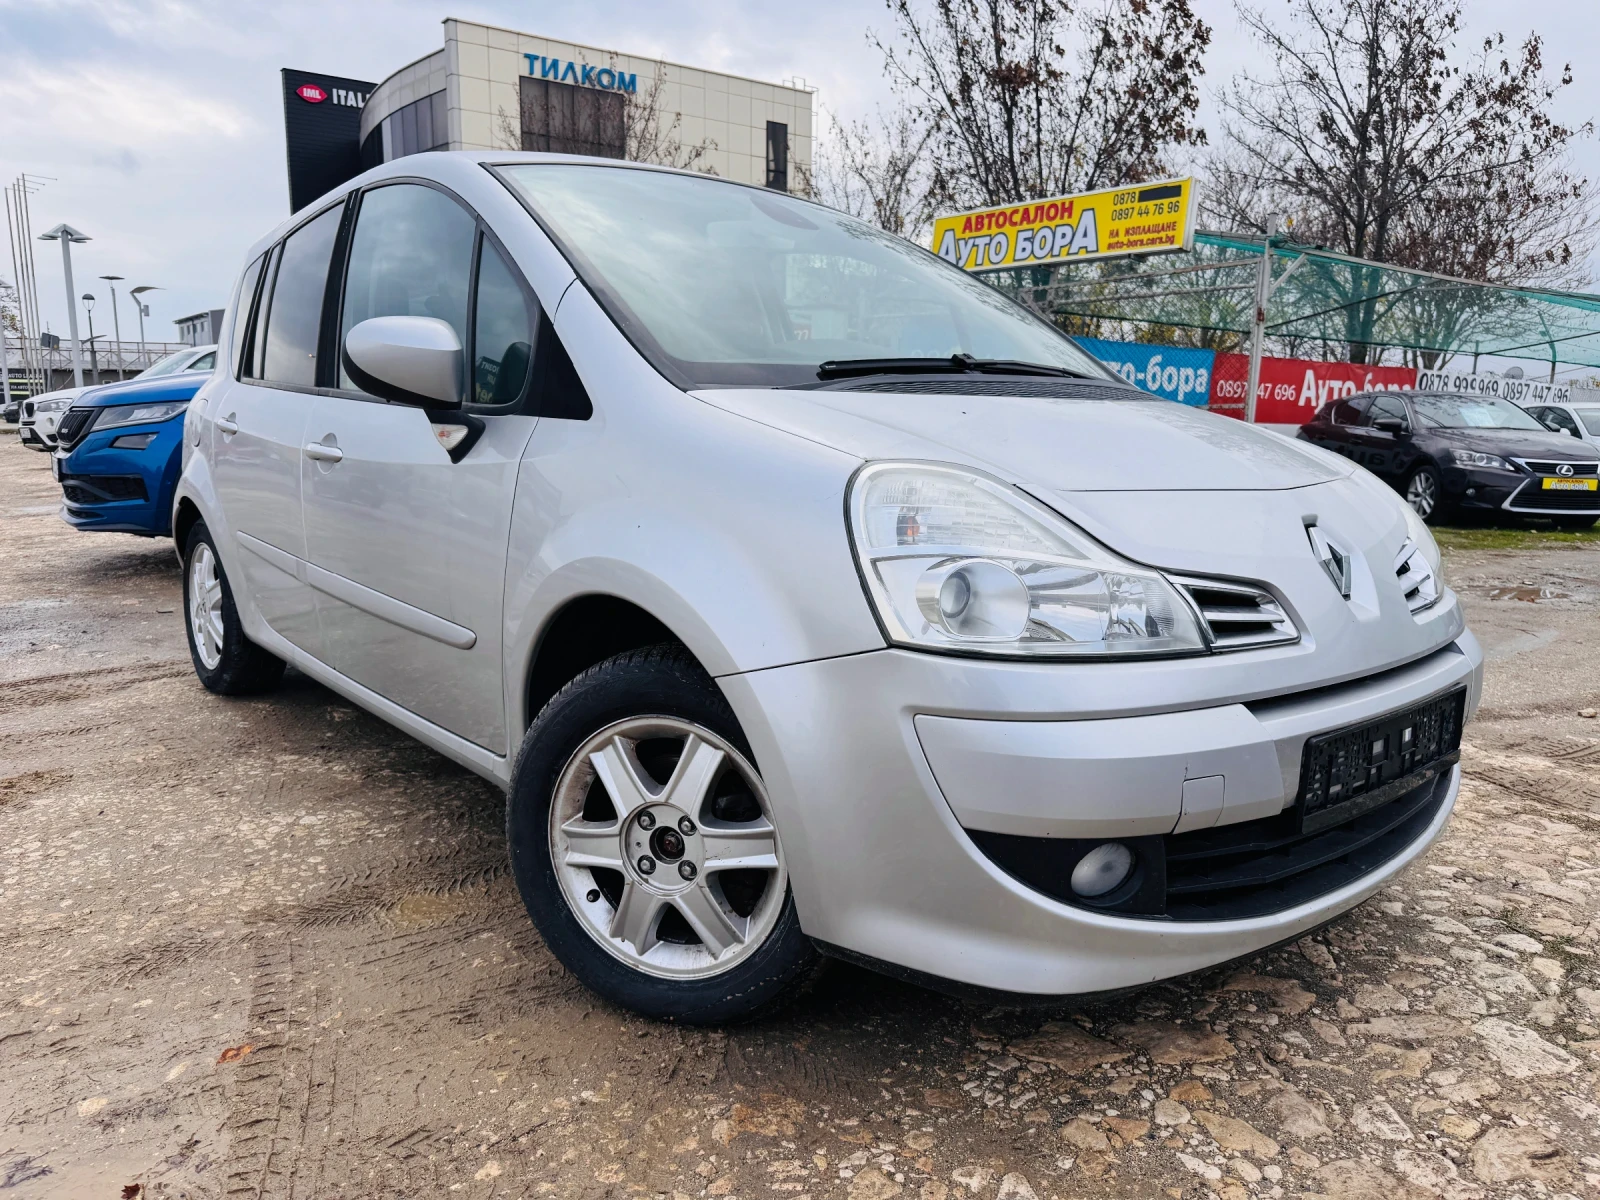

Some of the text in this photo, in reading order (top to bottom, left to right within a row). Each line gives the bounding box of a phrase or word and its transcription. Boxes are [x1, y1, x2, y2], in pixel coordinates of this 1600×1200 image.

[523, 53, 637, 93] ТИЛКОМ
[303, 87, 321, 99] IML
[1113, 192, 1136, 206] 0878
[962, 200, 1074, 234] АВТОСАЛОН
[1111, 200, 1180, 221] 0897 44 76 96
[1109, 228, 1119, 239] НА
[1274, 384, 1296, 401] 696
[1503, 381, 1530, 401] 0897
[1532, 384, 1552, 403] 447
